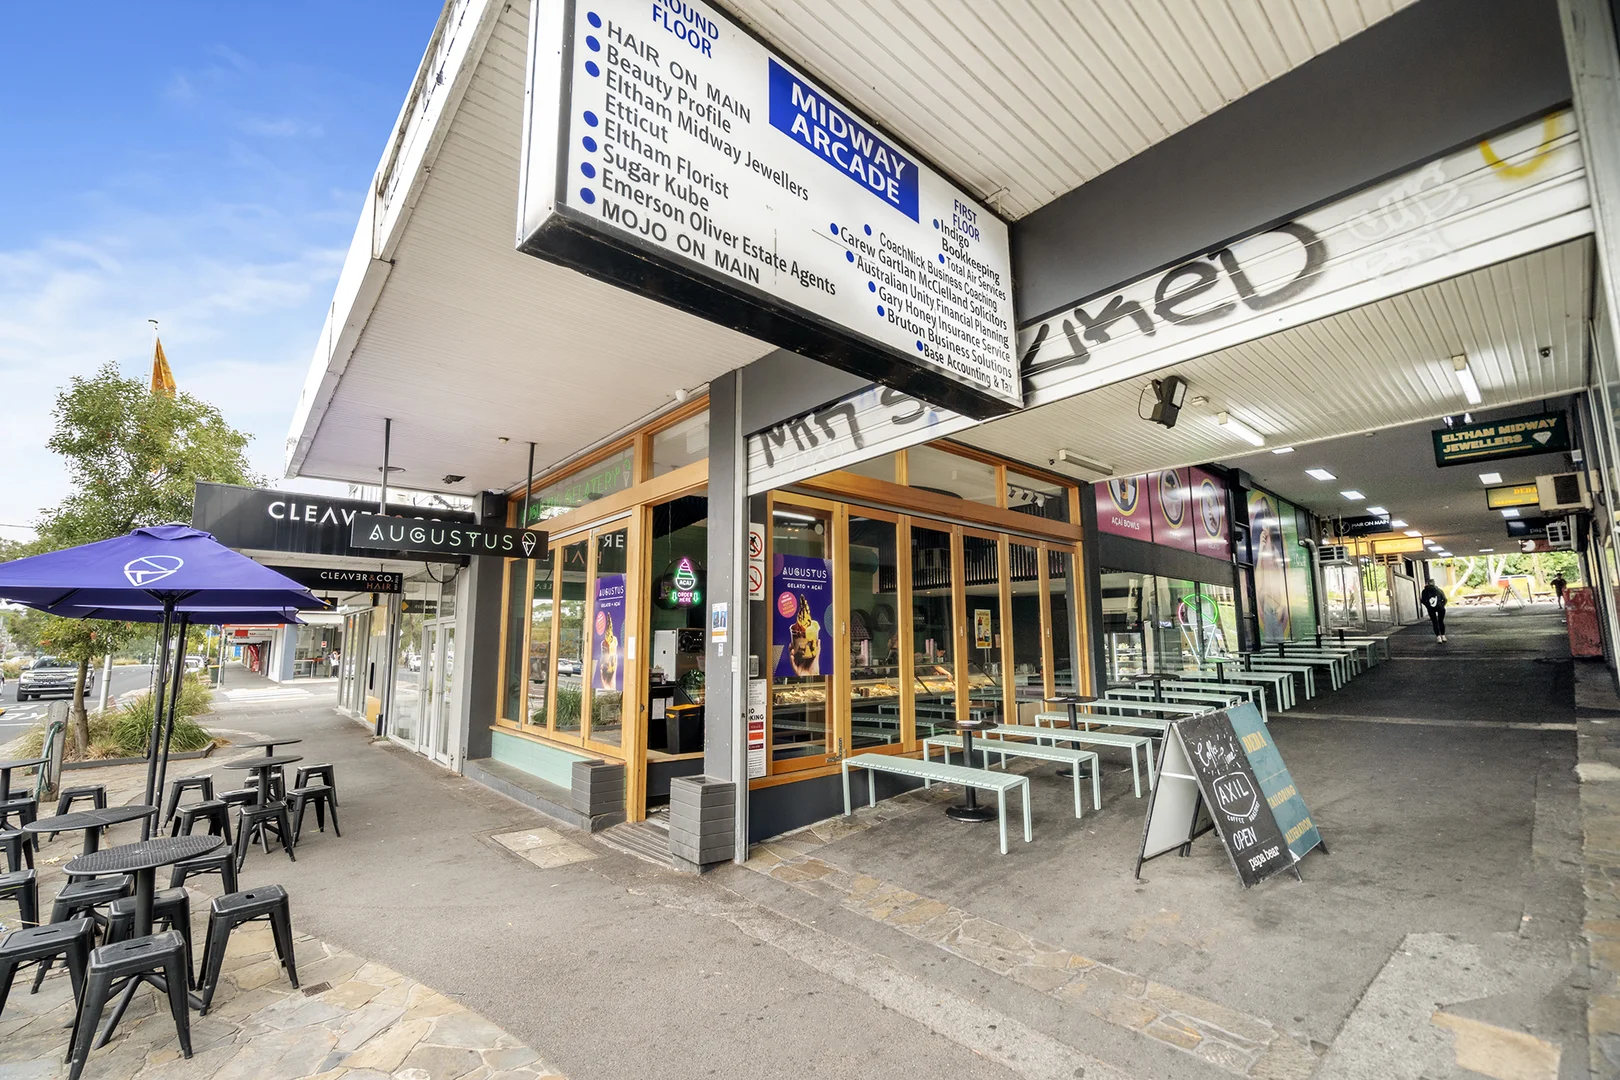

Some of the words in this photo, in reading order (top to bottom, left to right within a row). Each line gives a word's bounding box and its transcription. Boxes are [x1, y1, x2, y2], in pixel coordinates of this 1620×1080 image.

[653, 3, 712, 58] FLOOR
[658, 0, 718, 40] OUND
[607, 44, 672, 100] Beauty
[678, 87, 731, 133] Profile
[608, 20, 660, 67] HAIR
[670, 61, 697, 90] ON
[707, 83, 751, 123] MAIN
[606, 93, 668, 144] Etticut
[606, 68, 672, 122] Eltham
[678, 111, 741, 164] Midway
[745, 152, 809, 201] Jewellers
[791, 82, 906, 181] MIDWAY
[604, 118, 671, 169] Eltham
[678, 156, 729, 199] Florist
[604, 144, 660, 182] Sugar
[665, 176, 709, 212] Kube
[790, 113, 900, 206] ARCADE
[603, 168, 684, 224] Emerson
[690, 212, 738, 250] Oliver
[742, 237, 787, 272] Estate
[791, 264, 836, 296] Agents
[941, 220, 970, 248] Indigo
[953, 214, 980, 242] FLOOR
[954, 199, 977, 224] FIRST
[602, 198, 667, 242] MOJO
[676, 234, 705, 260] ON
[715, 250, 760, 284] MAIN
[942, 237, 1000, 286] Bookkeeping
[840, 227, 876, 258] Carew
[878, 250, 916, 282] Gartlan
[918, 272, 968, 310] McClelland
[970, 298, 1008, 331] Solicitors
[880, 232, 926, 271] CoachNick
[928, 260, 962, 292] Business
[964, 282, 998, 313] Coaching
[946, 257, 966, 275] Total
[966, 268, 977, 284] Air
[978, 276, 1006, 300] Services
[857, 256, 908, 295] Australian
[910, 286, 935, 310] Unity
[936, 299, 974, 329] Financial
[975, 319, 1009, 349] Planning
[879, 286, 903, 312] Gary
[906, 302, 937, 329] Honey
[938, 316, 980, 348] Insurance
[982, 338, 1011, 362] Service
[888, 308, 926, 340] Bruton
[928, 328, 970, 360] Business
[972, 353, 1012, 379] Solutions
[924, 344, 944, 364] Base
[946, 355, 992, 388] Accounting
[994, 375, 1000, 388] &
[1000, 377, 1013, 394] Tax
[1442, 428, 1495, 443] ELTHAM
[1498, 418, 1557, 434] MIDWAY
[1443, 434, 1522, 453] JEWELLERS
[369, 524, 513, 550] AUGUSTUS
[1124, 519, 1140, 530] BOWLS
[1352, 522, 1364, 530] HAIR
[599, 586, 624, 597] AUGUSTUS
[782, 566, 827, 579] AUGUSTUS
[787, 582, 806, 590] GELATO
[1242, 731, 1267, 754] DEDA
[1219, 778, 1249, 805] AXIL
[1266, 784, 1296, 809] TAILORING
[1233, 826, 1258, 850] OPEN
[1248, 853, 1267, 872] papa
[1262, 846, 1280, 860] bear
